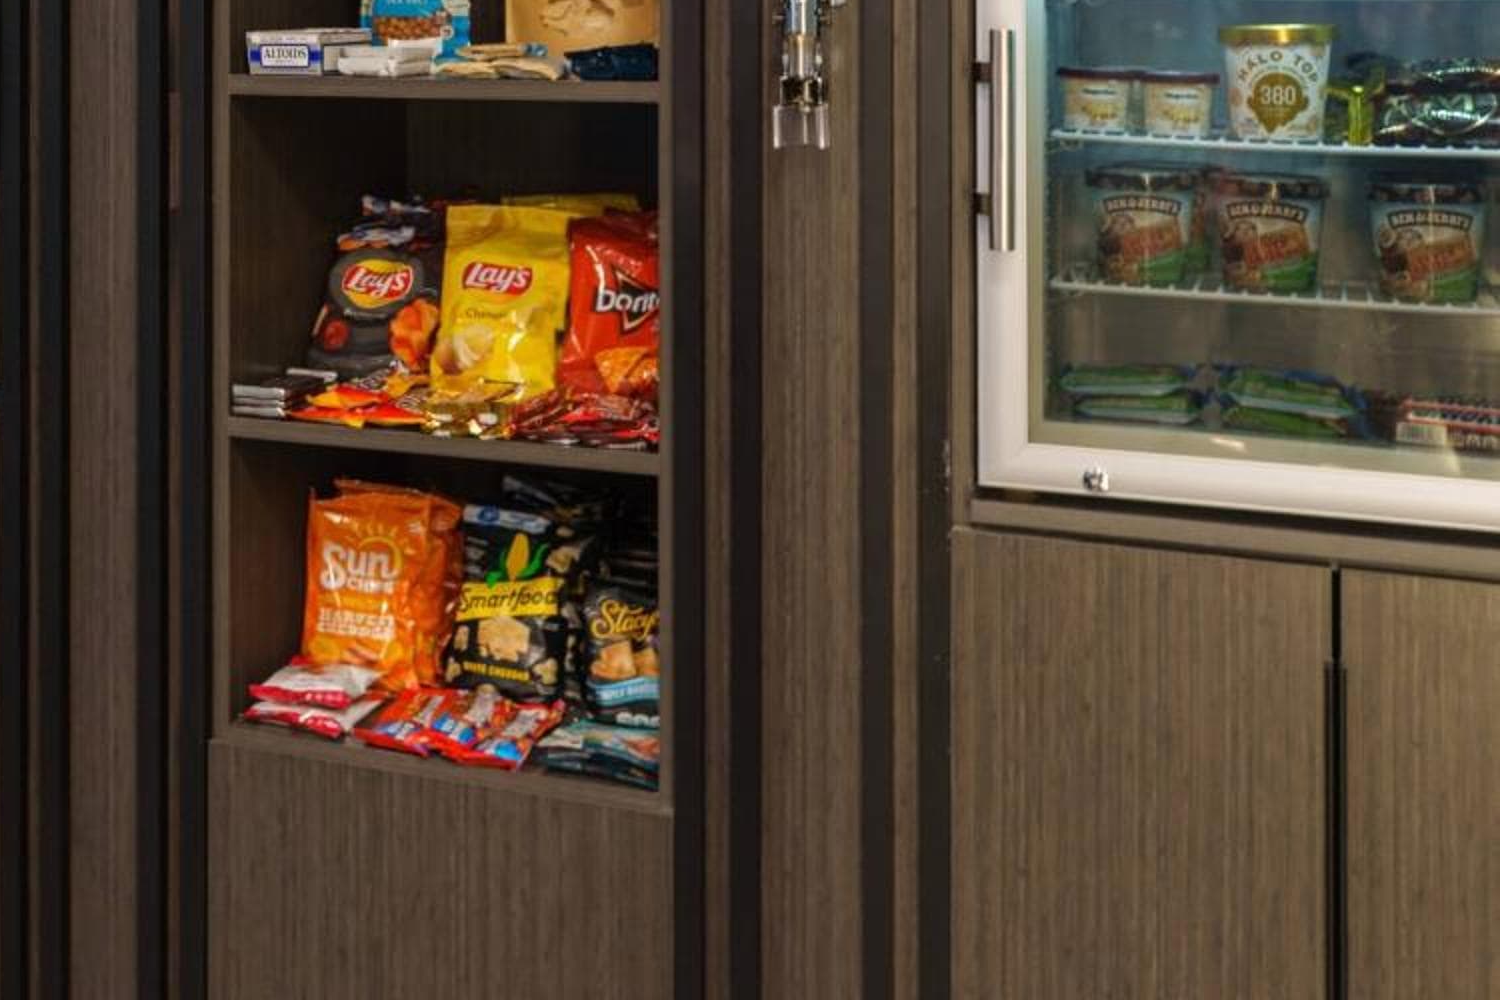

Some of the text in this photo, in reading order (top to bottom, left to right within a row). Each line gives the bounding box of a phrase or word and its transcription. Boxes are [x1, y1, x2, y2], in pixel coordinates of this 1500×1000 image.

[263, 47, 307, 60] ALTOIDS
[1260, 84, 1296, 105] 380
[345, 266, 408, 297] Lay's
[465, 262, 531, 293] Lay's
[320, 541, 401, 591] Sun
